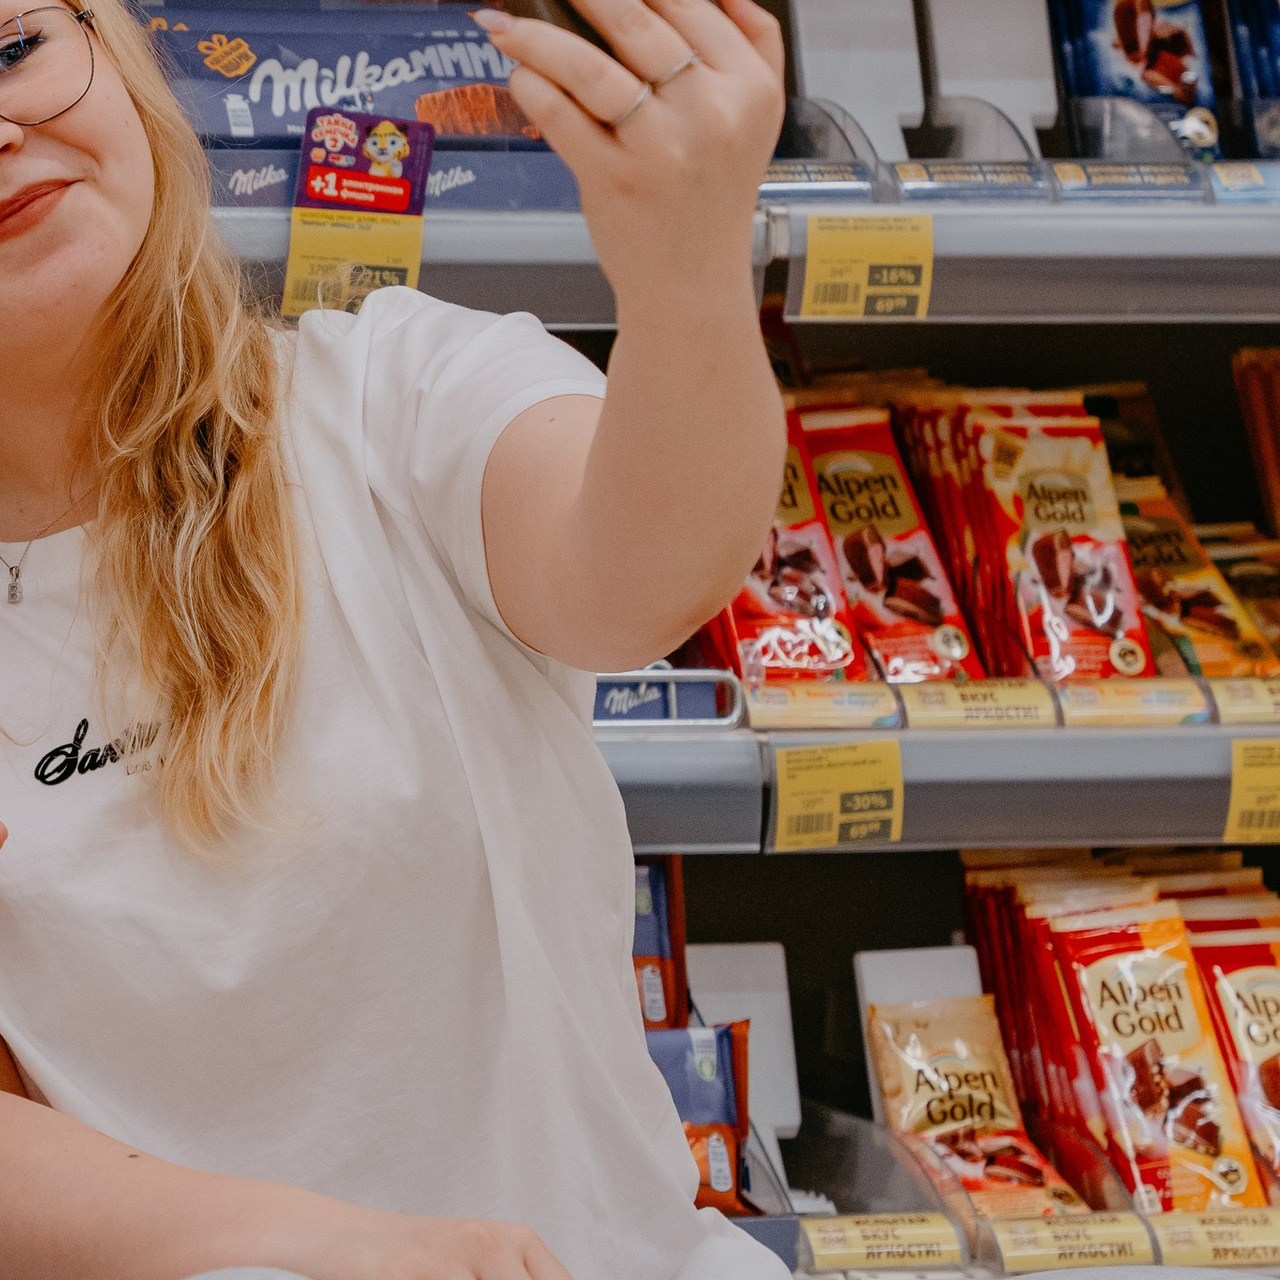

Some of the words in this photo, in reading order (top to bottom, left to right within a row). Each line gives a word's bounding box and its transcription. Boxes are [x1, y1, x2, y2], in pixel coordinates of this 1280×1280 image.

[249, 51, 423, 117] Milka
[331, 137, 338, 149] 2
[229, 165, 289, 196] Milka
[311, 172, 338, 197] +1
[819, 473, 901, 501] Alpen
[1028, 482, 1087, 503] Alpen
[830, 493, 902, 524] Gold
[1033, 498, 1085, 522] Gold
[1099, 979, 1183, 1015] Alpen
[1235, 991, 1280, 1023] Alp
[1112, 1009, 1184, 1037] Gold
[915, 1066, 998, 1099] Alpen
[926, 1090, 996, 1123] Gold
[866, 1242, 942, 1260] ЯРКОСТИ!
[1057, 1242, 1134, 1261] ЯРКОСТИ!
